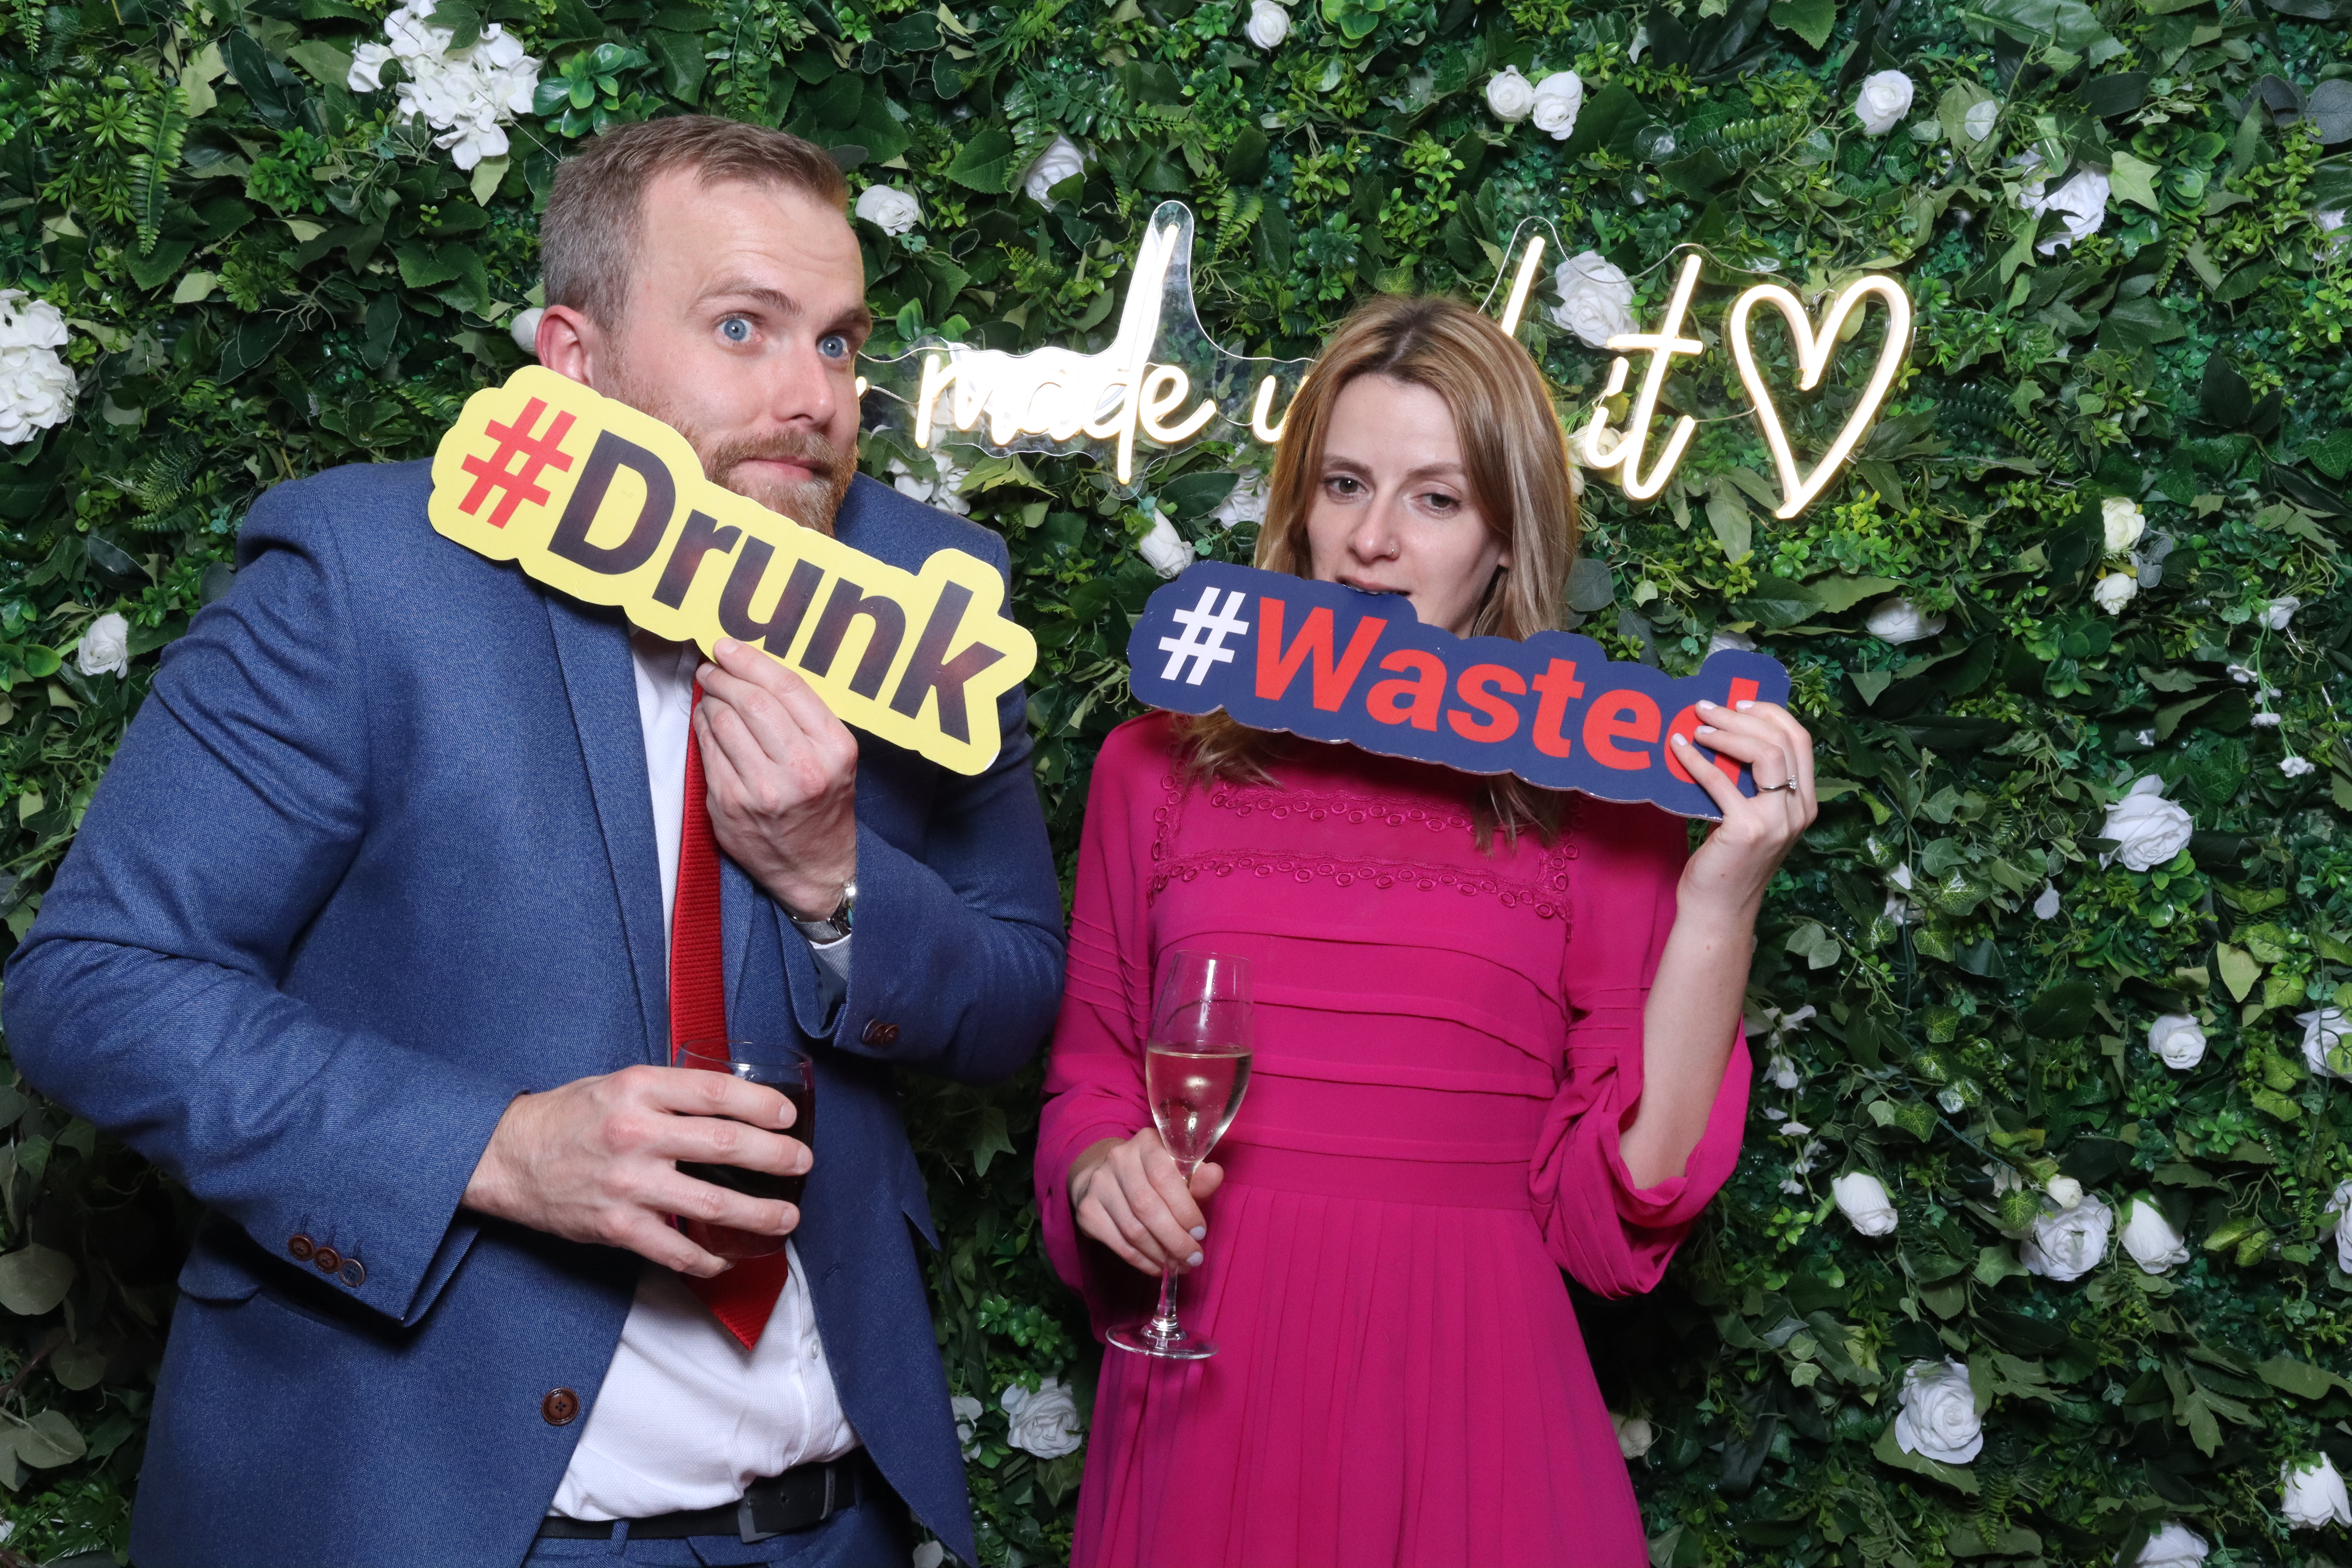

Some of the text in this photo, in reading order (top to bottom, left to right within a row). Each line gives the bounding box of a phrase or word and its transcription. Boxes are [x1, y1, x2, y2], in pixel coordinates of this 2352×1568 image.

[914, 224, 1217, 485] made
[1584, 254, 1703, 501] it
[458, 397, 1004, 745] #Drunk
